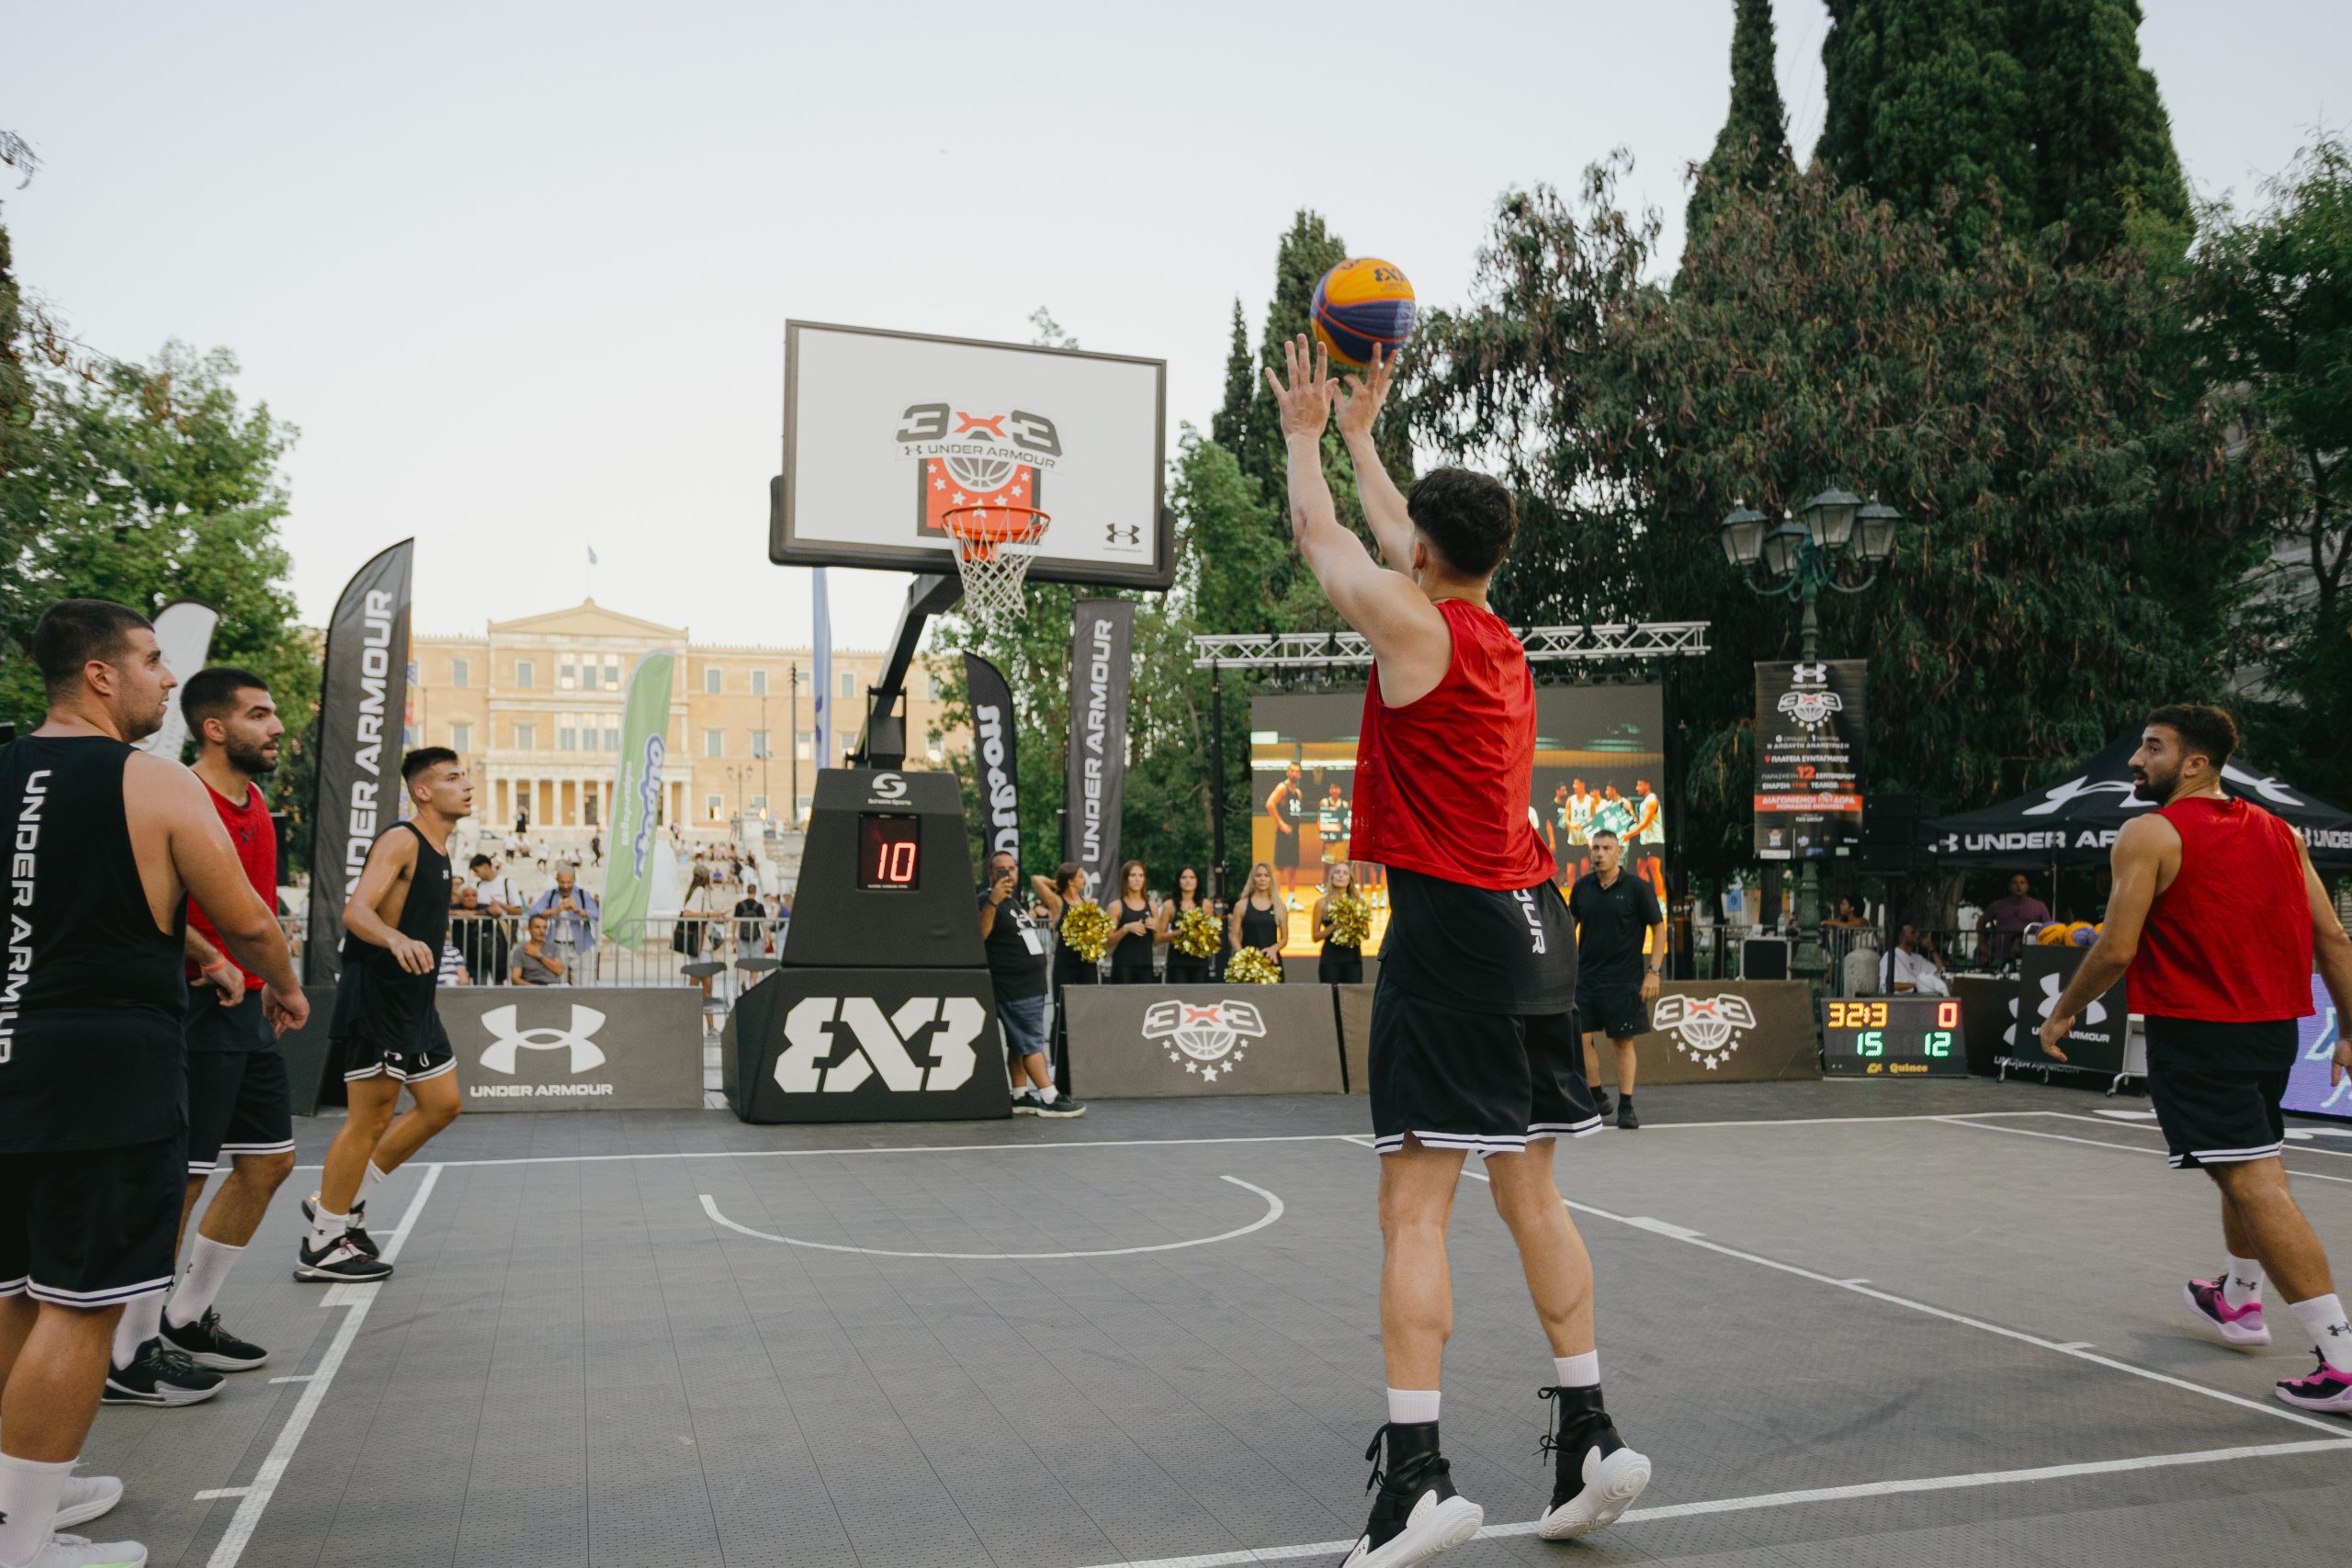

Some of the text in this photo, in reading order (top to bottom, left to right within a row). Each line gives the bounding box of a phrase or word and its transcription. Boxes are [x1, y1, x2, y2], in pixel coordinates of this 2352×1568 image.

[928, 444, 1056, 469] UNDER ARMOUR
[344, 588, 393, 905] NDER ARMOUR
[1081, 618, 1114, 863] UNDER ARMOUR
[1797, 765, 1815, 780] 12
[1964, 830, 2066, 852] UNDER
[2313, 829, 2352, 849] UNDE
[877, 842, 917, 882] 10
[0, 769, 52, 1064] UNDER ARMUR
[1938, 1001, 1959, 1029] 0
[1856, 1031, 1951, 1057] 15 12
[469, 1083, 614, 1098] UNDER ARMOUR
